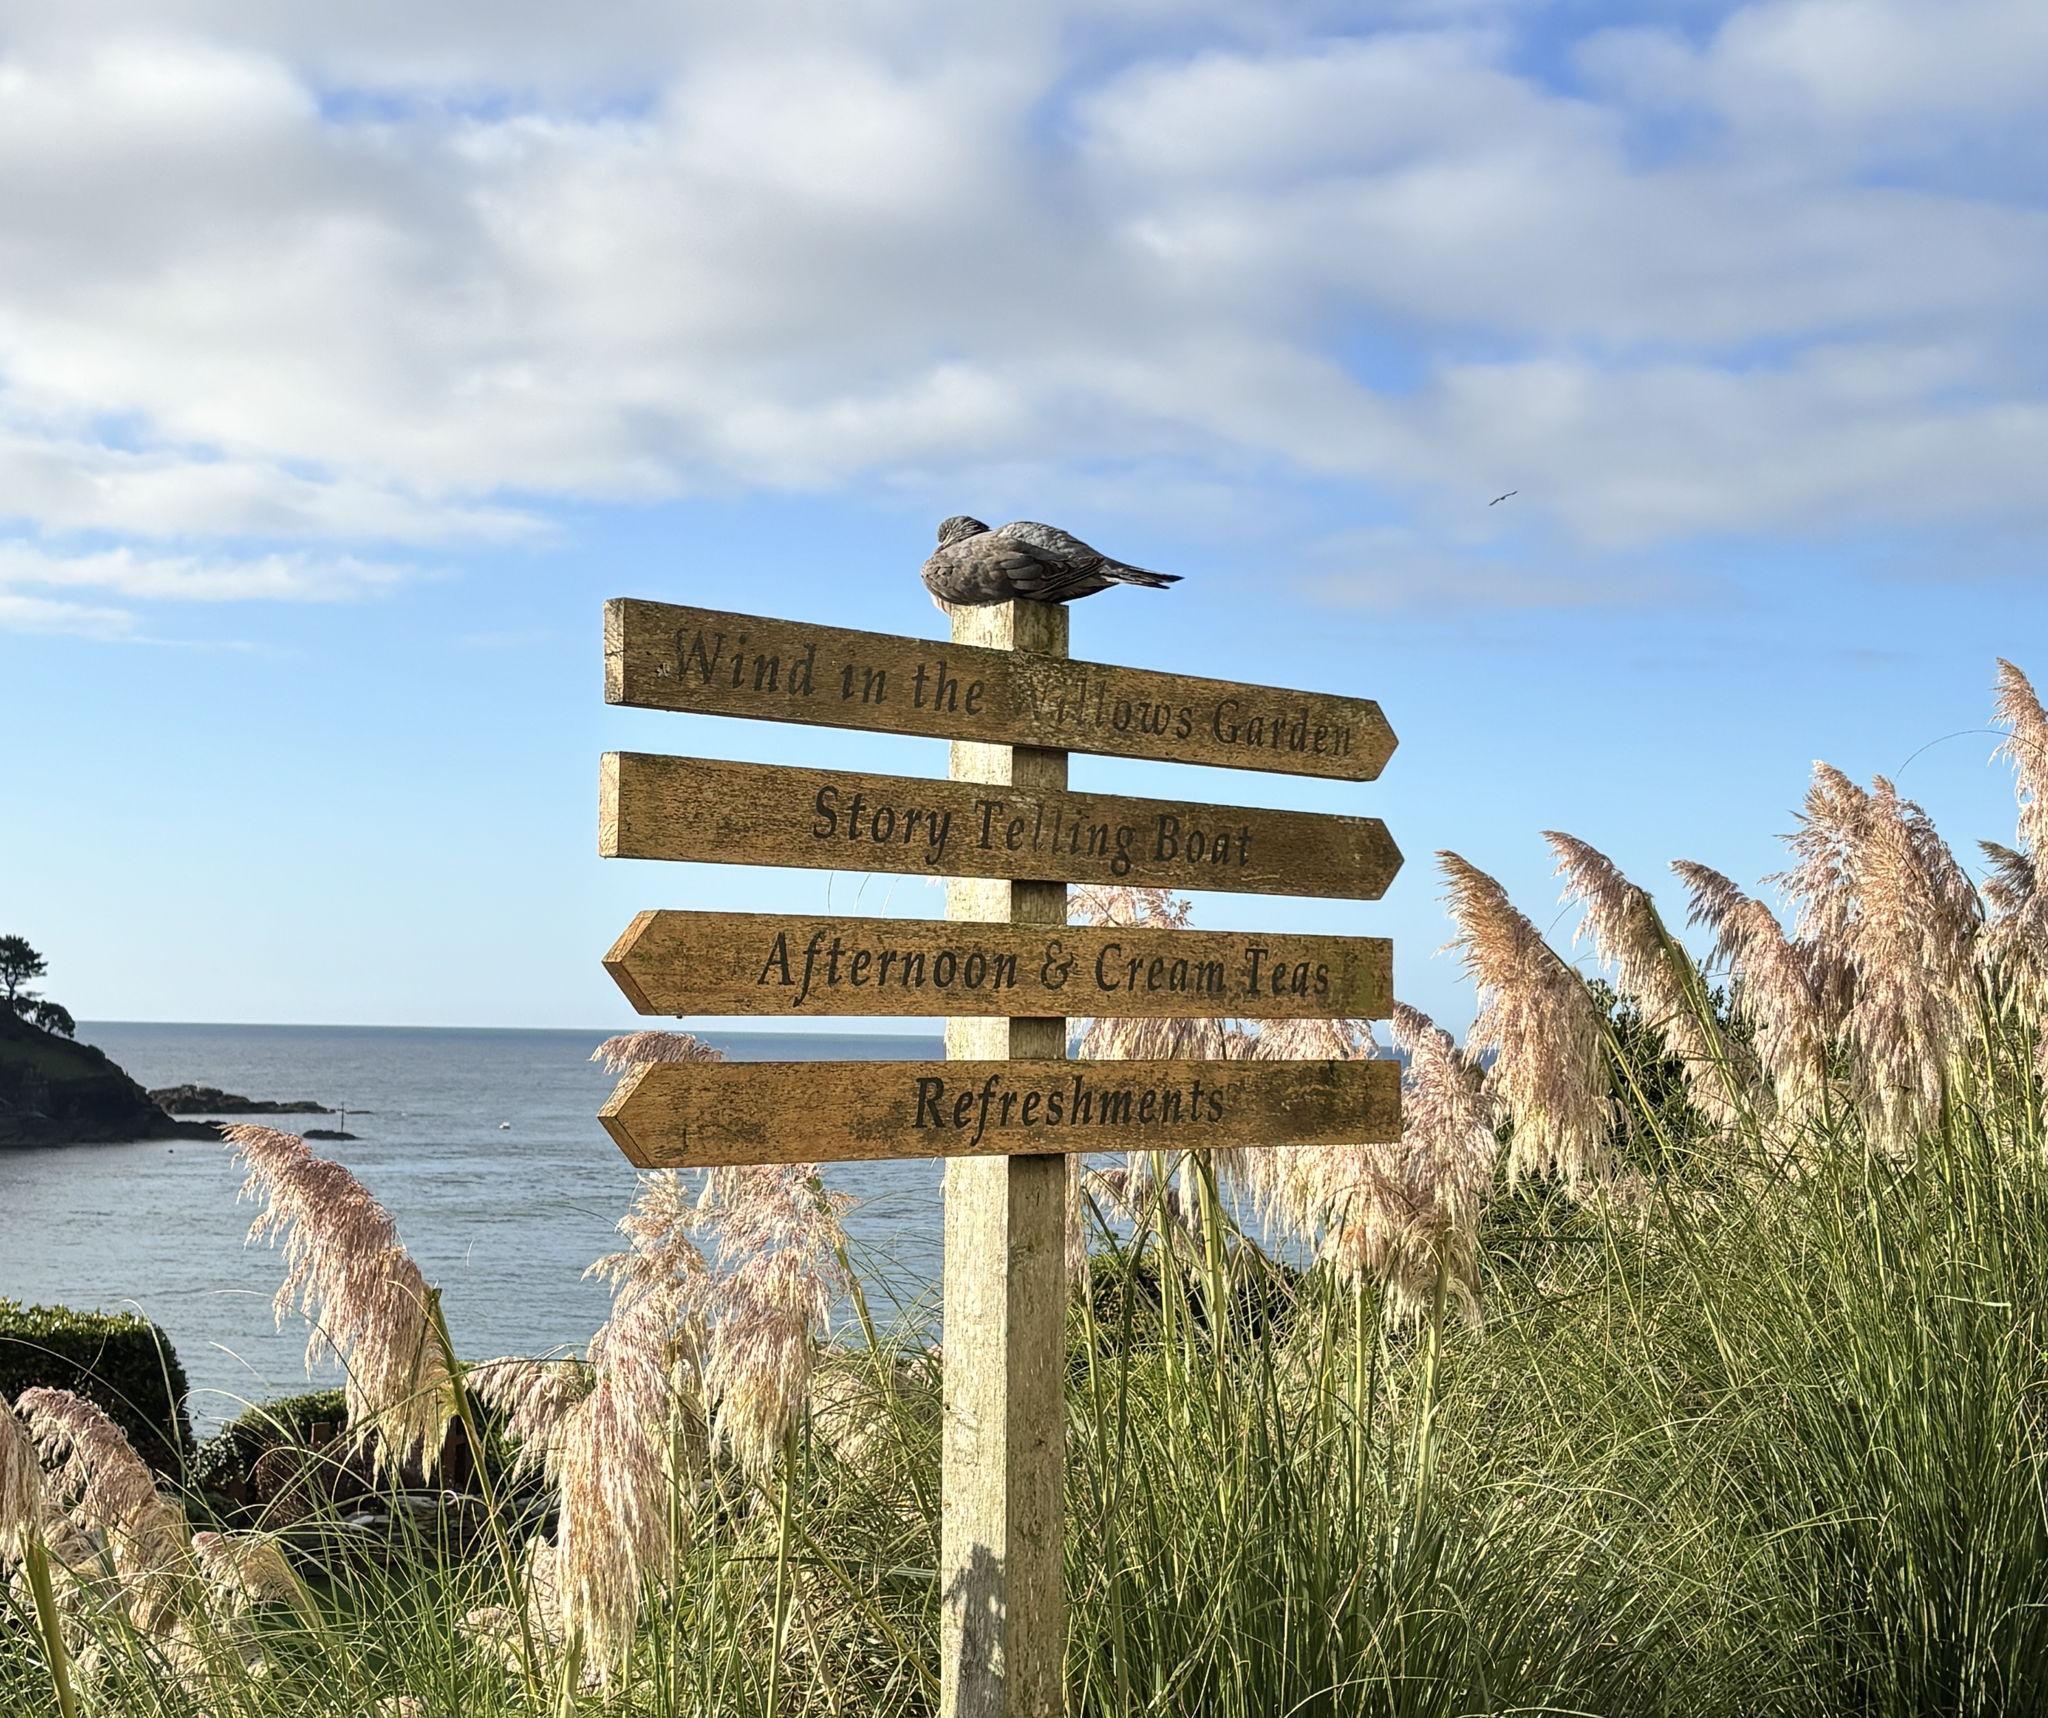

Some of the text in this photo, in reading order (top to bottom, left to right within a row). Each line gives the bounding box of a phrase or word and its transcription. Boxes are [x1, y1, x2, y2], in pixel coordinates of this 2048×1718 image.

[674, 628, 817, 696] Wind
[841, 650, 888, 705] in
[911, 660, 985, 715] the
[1211, 699, 1352, 756] Garden
[812, 785, 1254, 877] Story Telling Boat
[758, 930, 1330, 1007] Afternoon & Cream Teas
[911, 1073, 1225, 1147] Refreshments
